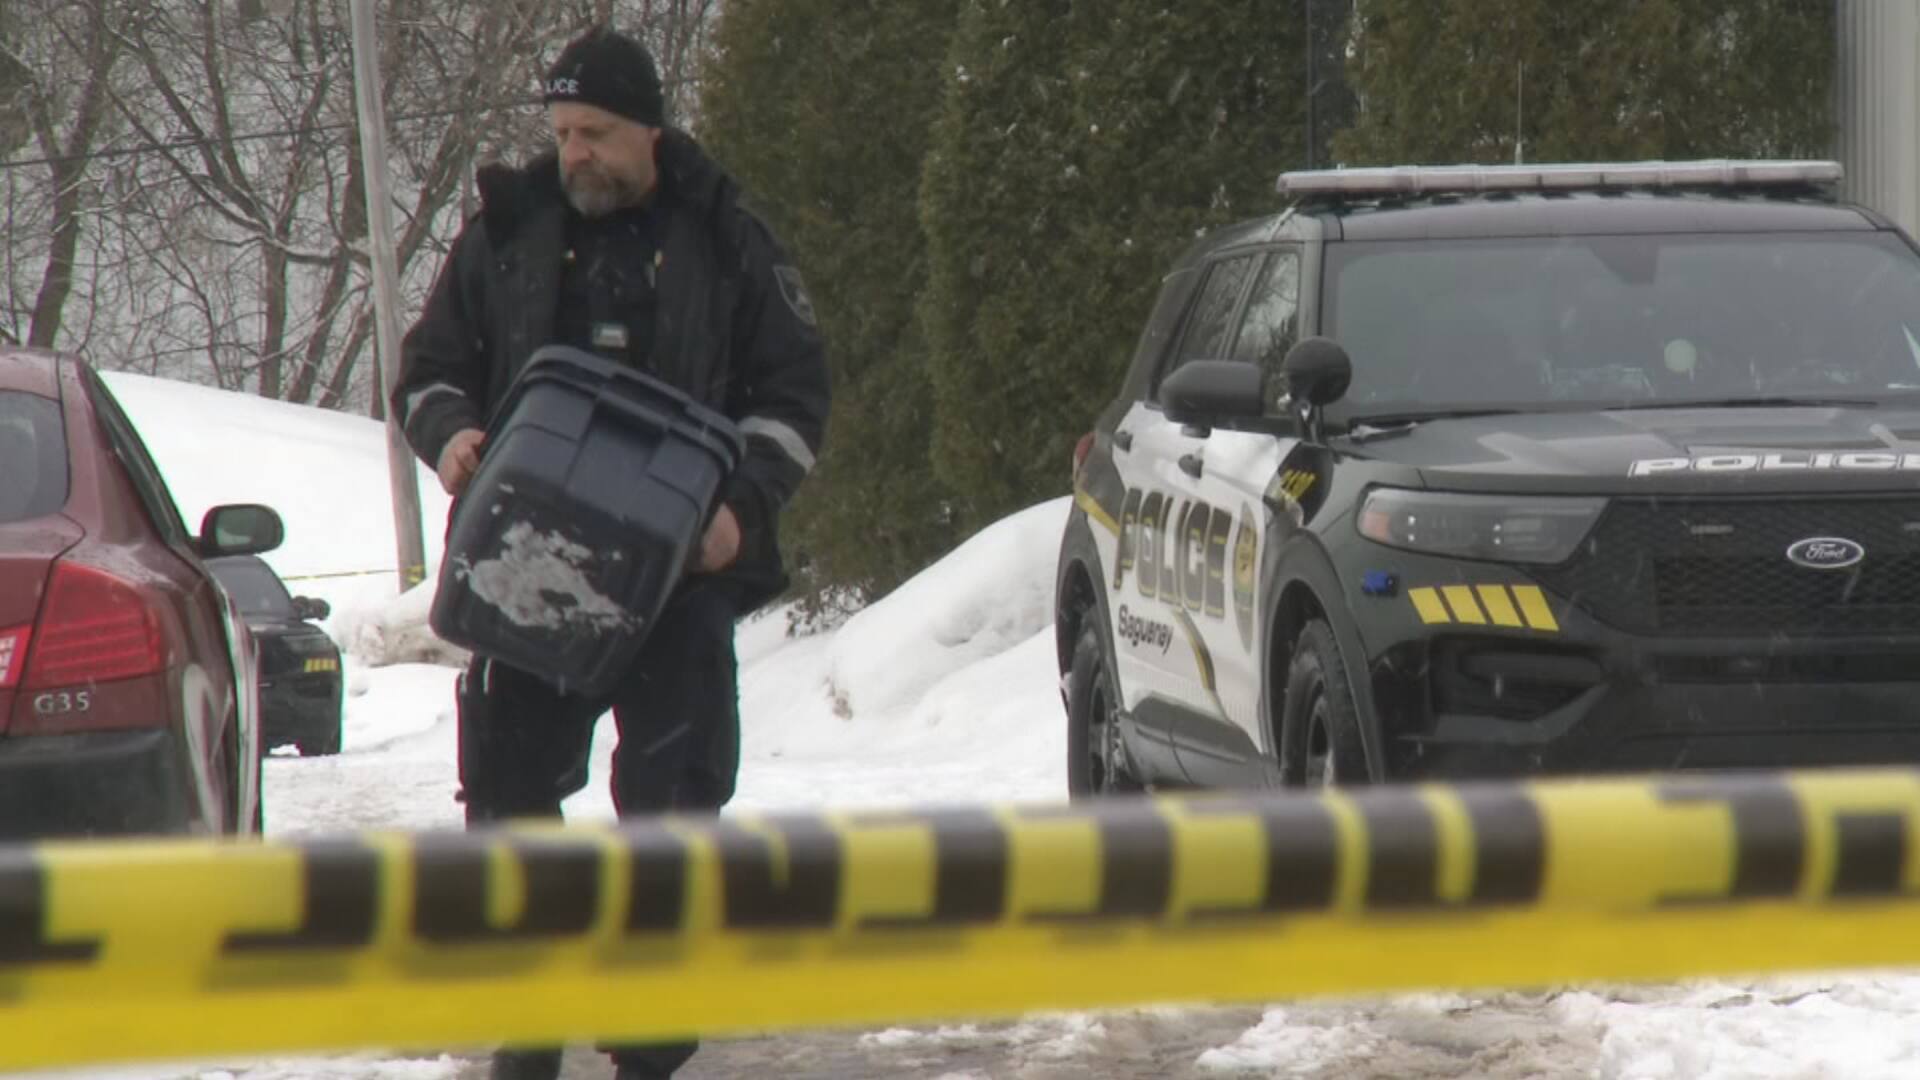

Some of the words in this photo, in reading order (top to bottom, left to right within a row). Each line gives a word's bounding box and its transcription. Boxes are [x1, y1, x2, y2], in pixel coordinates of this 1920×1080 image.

[1114, 487, 1232, 619] POLICE
[1805, 543, 1847, 560] Ford
[1118, 604, 1173, 655] Saguenay
[33, 691, 90, 712] G35
